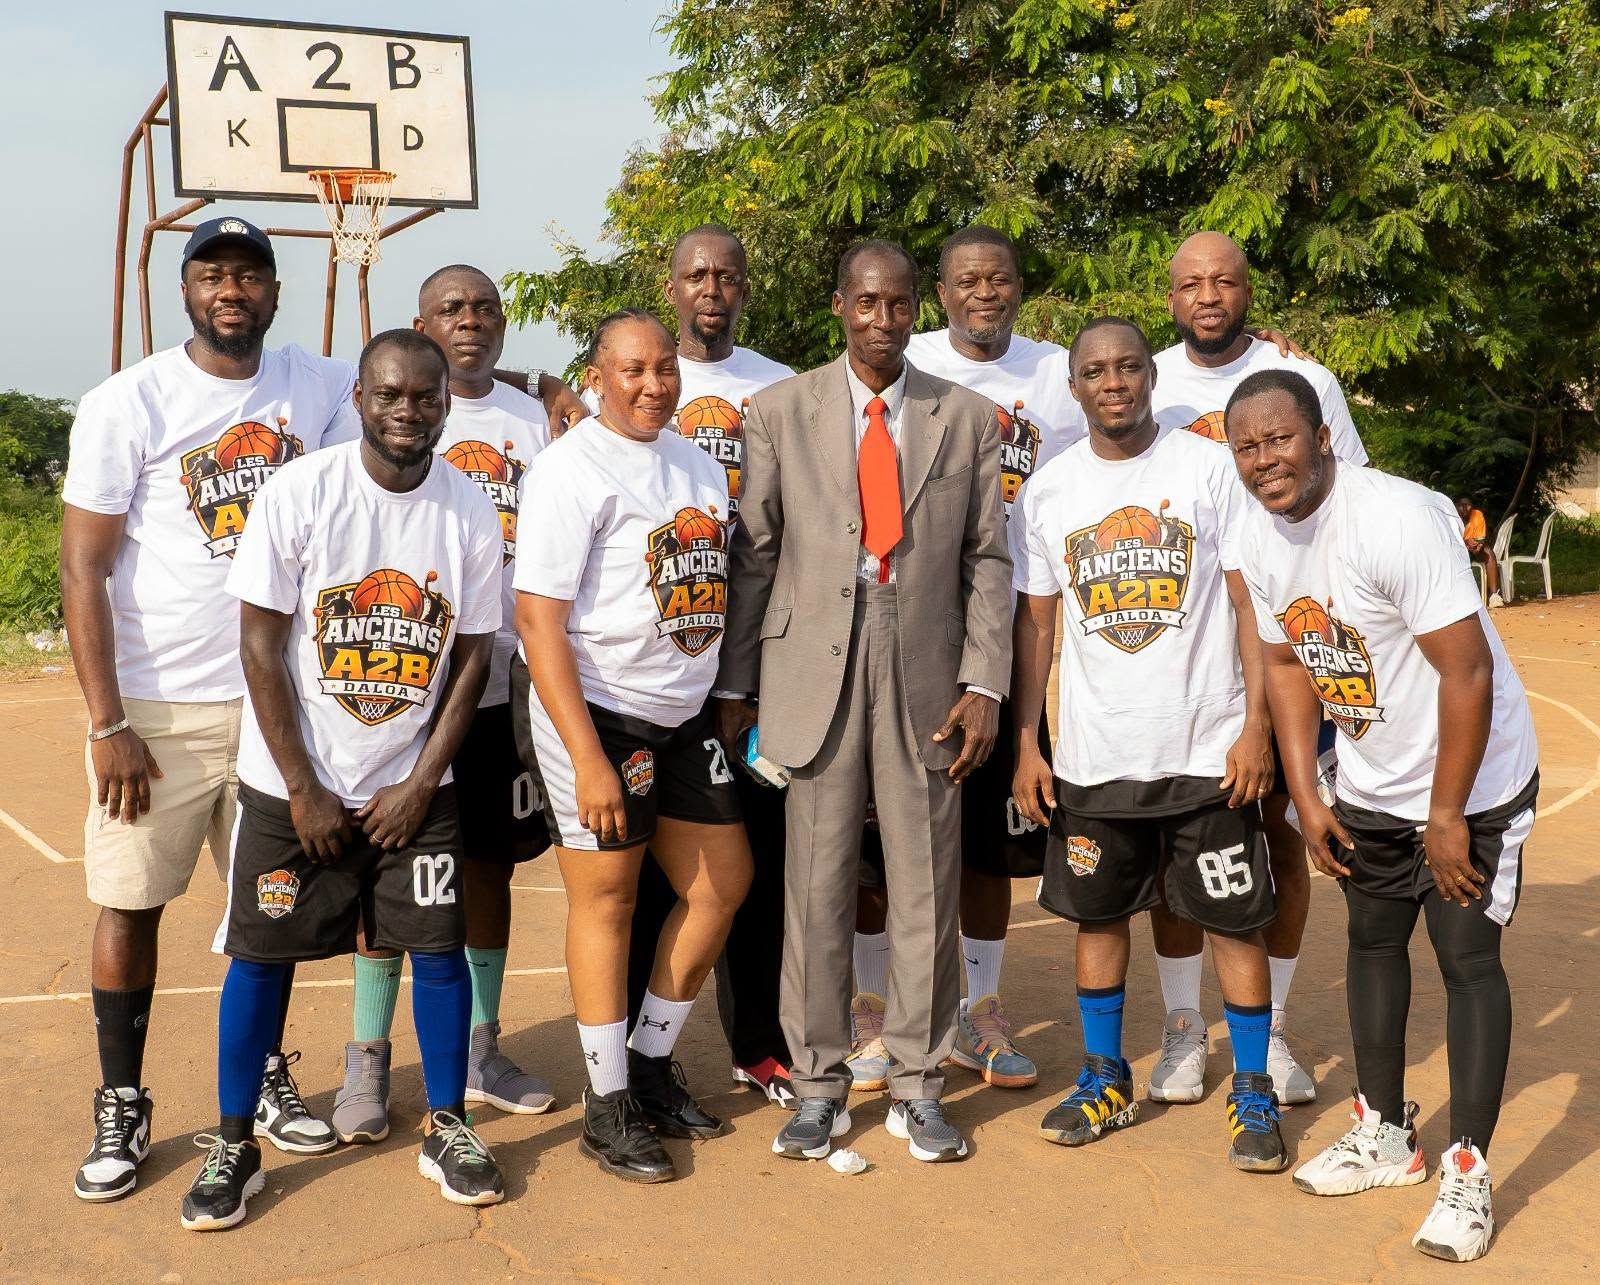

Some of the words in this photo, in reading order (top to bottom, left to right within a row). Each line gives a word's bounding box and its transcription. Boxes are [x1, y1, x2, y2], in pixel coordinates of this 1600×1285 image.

[208, 35, 262, 92] A
[305, 41, 351, 91] 2
[386, 41, 422, 91] B
[227, 118, 251, 147] K
[403, 124, 424, 151] D
[697, 427, 725, 438] LES
[236, 455, 266, 469] LES
[199, 466, 280, 508] ANCI
[692, 539, 710, 550] LES
[1115, 538, 1142, 550] LES
[1077, 548, 1187, 586] ANCIENS
[695, 574, 708, 583] DE
[1119, 571, 1137, 581] DE
[1086, 578, 1180, 617] A2B
[371, 605, 401, 617] LES
[1104, 610, 1163, 625] DALOA
[677, 614, 721, 629] DALOA
[322, 615, 443, 654] ANCIENS
[371, 641, 391, 651] DE
[1292, 643, 1370, 673] CIENS
[325, 647, 430, 687] A2B
[1315, 668, 1329, 677] DE
[343, 682, 409, 698] DALOA
[1315, 677, 1375, 706] 2B
[1323, 701, 1363, 718] ALOA
[513, 771, 545, 819] 0
[1196, 843, 1253, 899] 85
[412, 853, 456, 907] 02
[261, 884, 296, 896] ANCIENS
[261, 893, 293, 906] A2B
